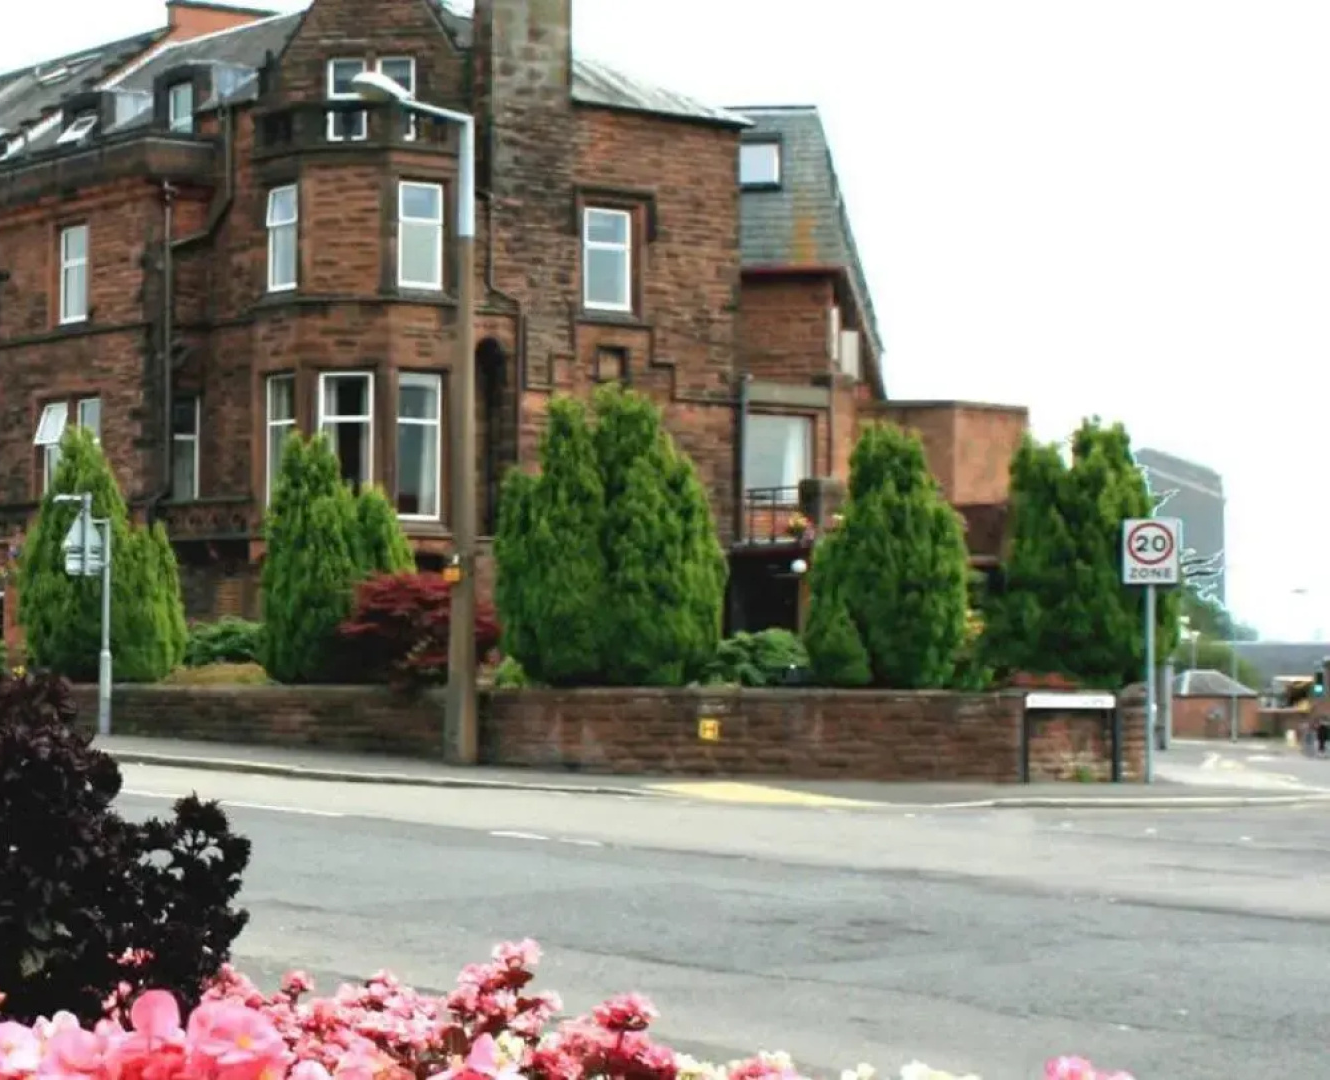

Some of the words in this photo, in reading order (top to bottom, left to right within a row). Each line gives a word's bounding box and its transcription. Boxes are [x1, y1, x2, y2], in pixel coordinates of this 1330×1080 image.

[1136, 535, 1166, 552] 20
[1129, 567, 1172, 579] ZONE
[702, 721, 717, 737] H
